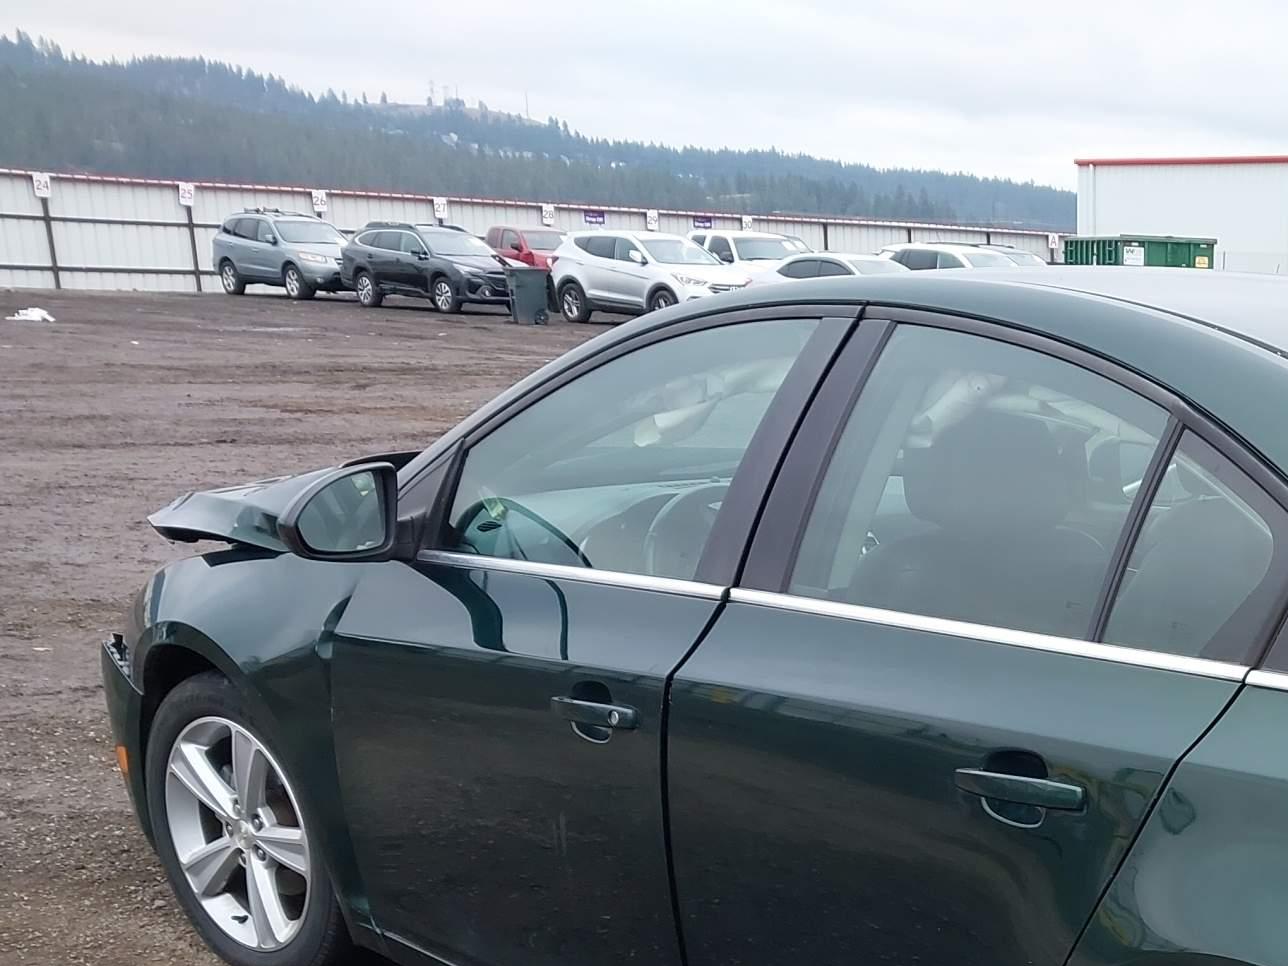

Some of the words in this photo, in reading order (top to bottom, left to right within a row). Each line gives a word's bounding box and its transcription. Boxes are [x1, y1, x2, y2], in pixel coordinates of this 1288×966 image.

[36, 181, 49, 191] 24
[180, 188, 192, 199] 25
[313, 196, 326, 206] 26
[434, 203, 446, 213] 27
[542, 209, 554, 219] 28
[647, 215, 658, 225] 29
[743, 220, 752, 230] 30
[1050, 235, 1057, 245] A
